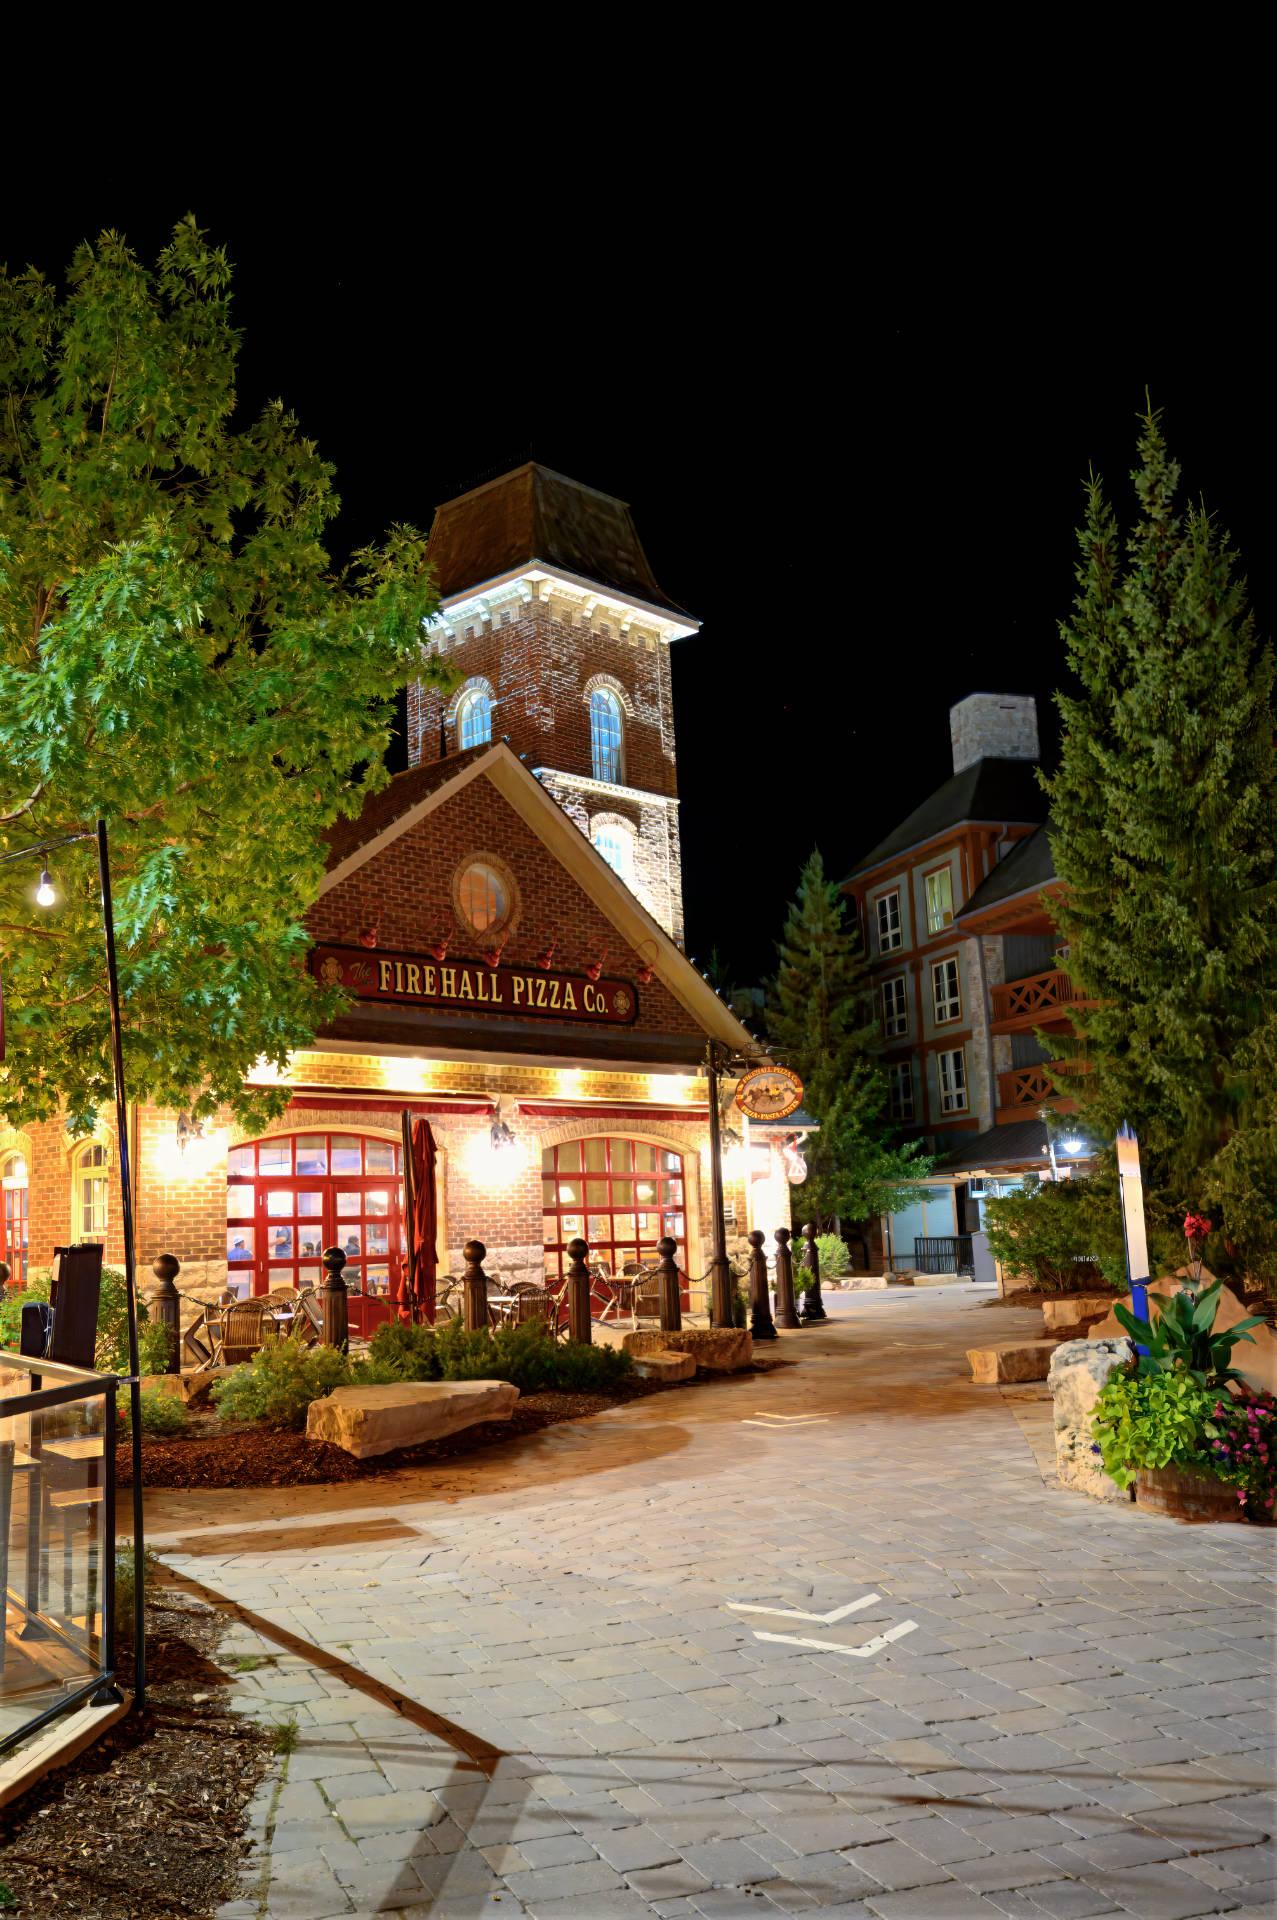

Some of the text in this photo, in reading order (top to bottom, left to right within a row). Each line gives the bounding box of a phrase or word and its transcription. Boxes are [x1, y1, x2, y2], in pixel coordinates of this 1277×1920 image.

[378, 960, 503, 1003] FIREHALL
[511, 976, 578, 1011] PIZZA
[583, 984, 609, 1013] Co.
[760, 1112, 780, 1121] PASTA
